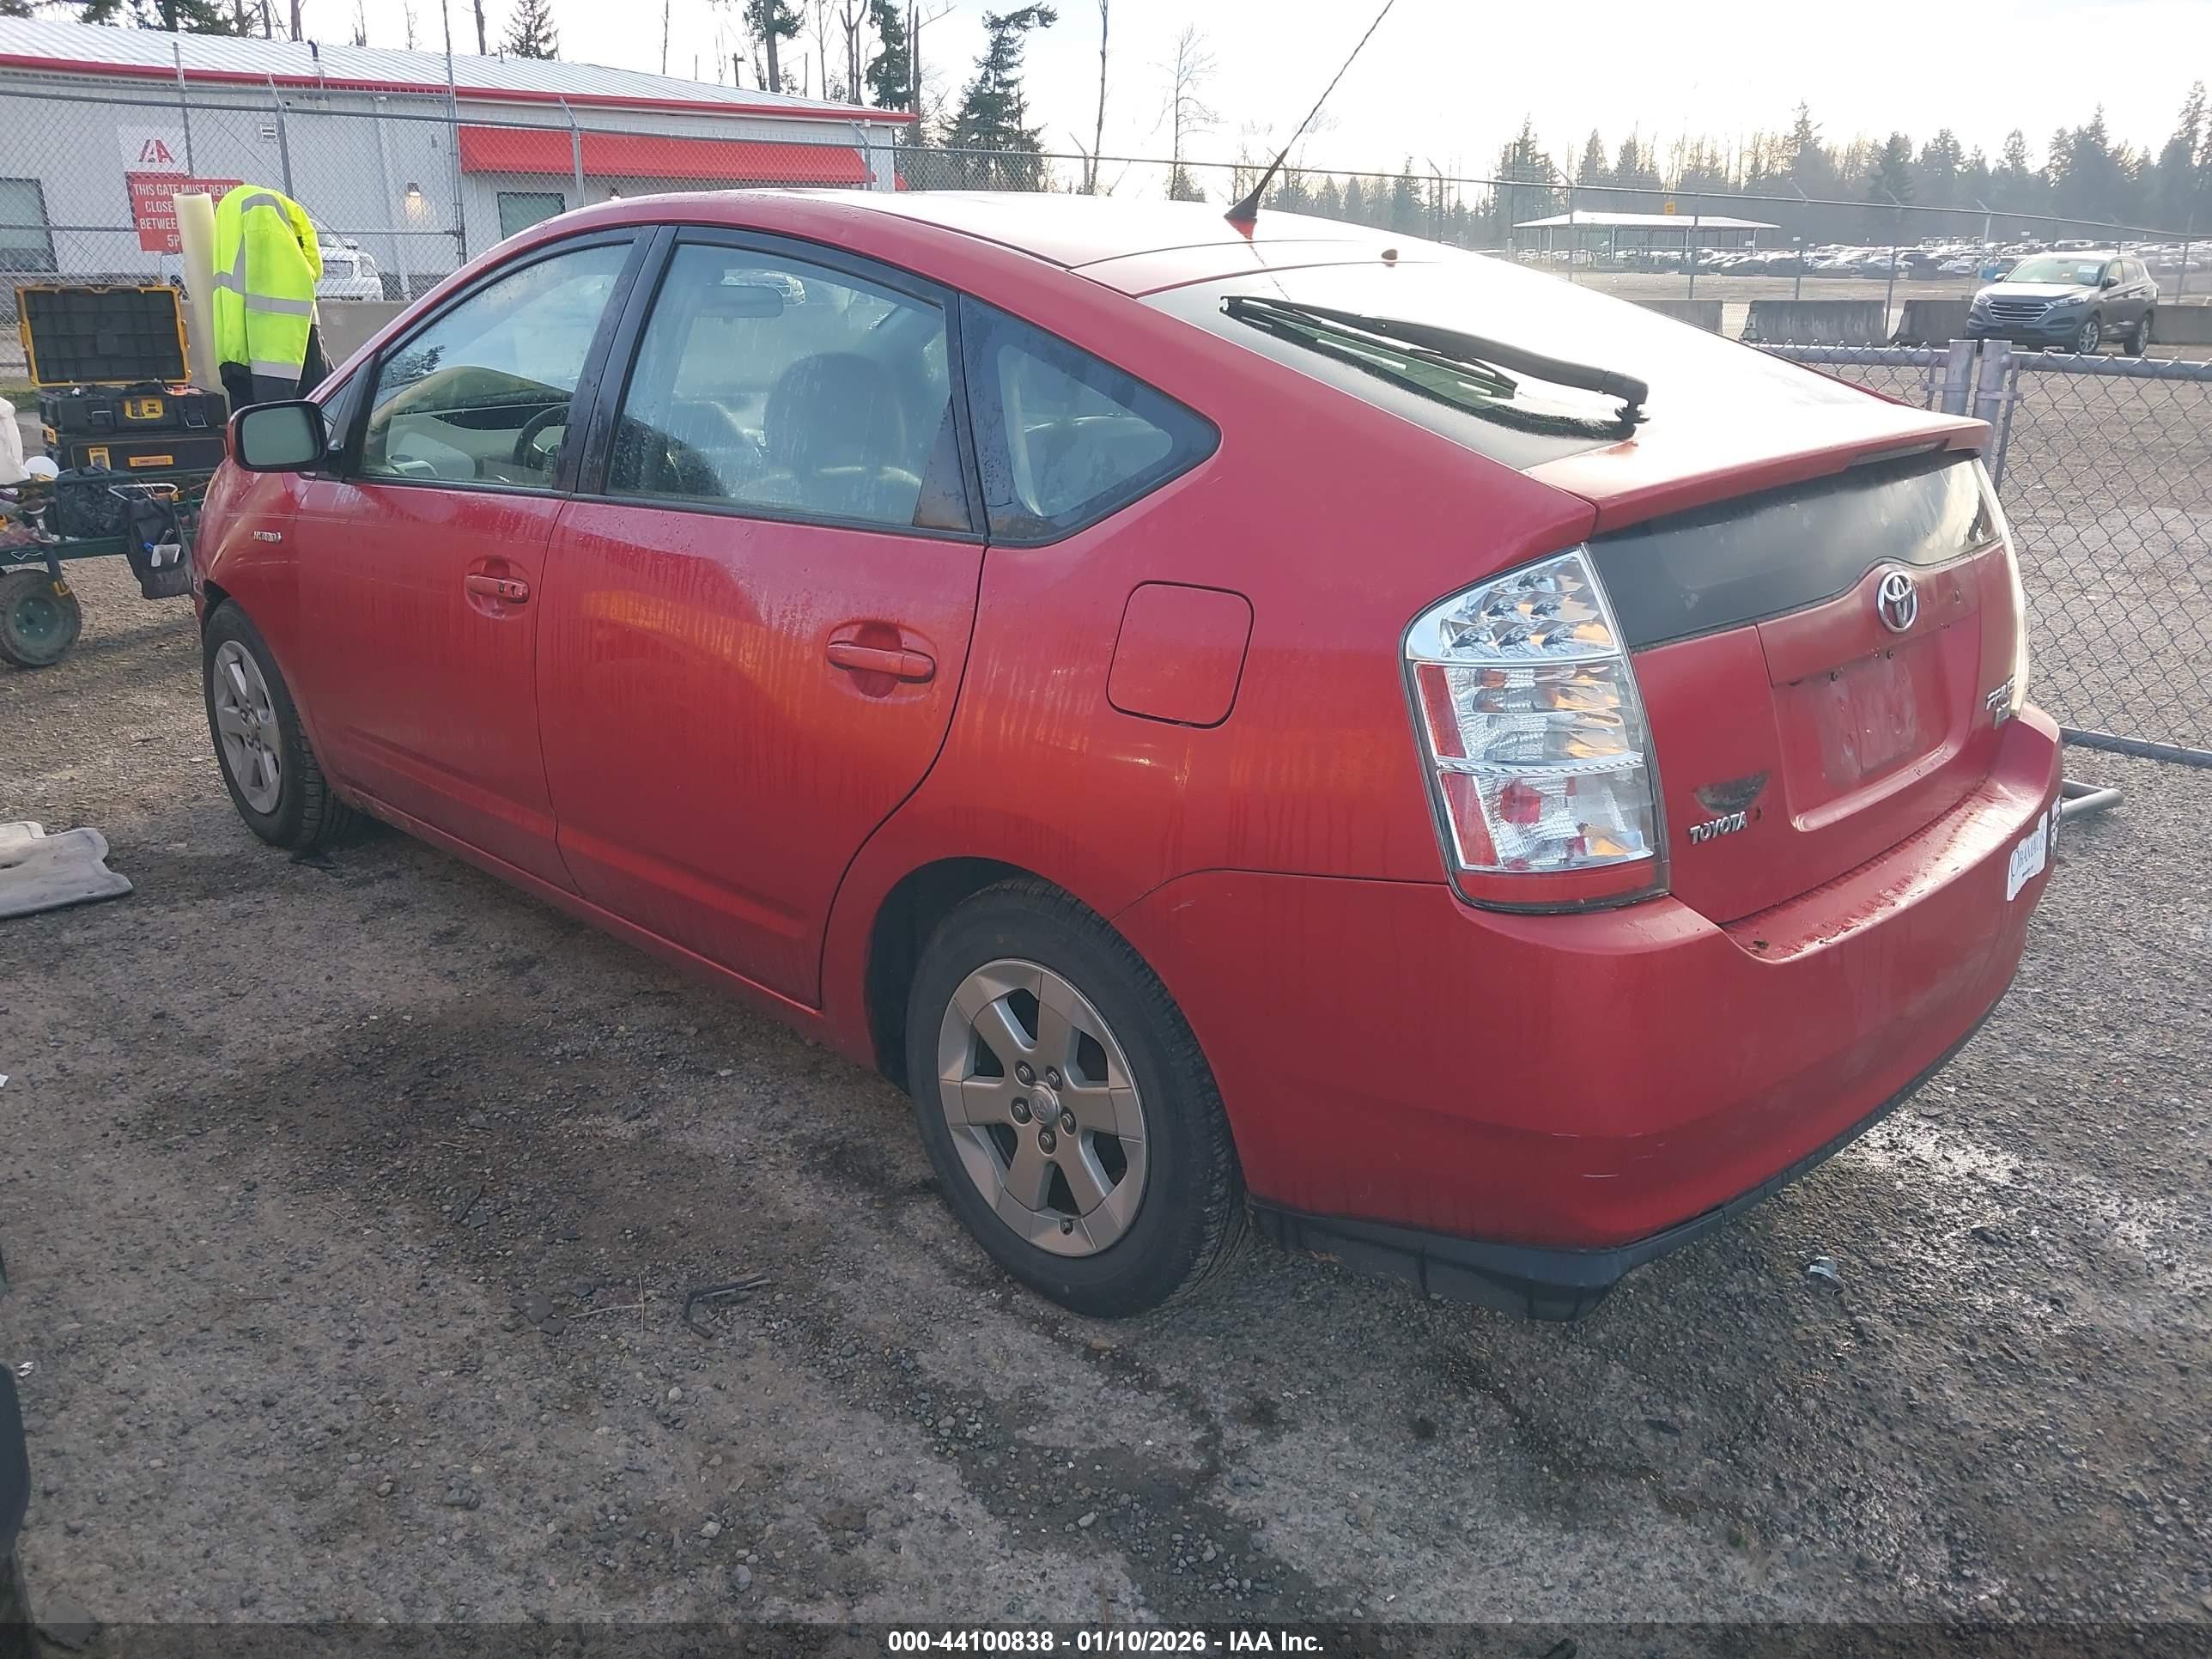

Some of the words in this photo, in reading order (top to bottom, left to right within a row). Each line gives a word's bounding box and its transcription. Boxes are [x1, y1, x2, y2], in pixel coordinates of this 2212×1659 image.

[132, 183, 156, 197] THIS
[156, 183, 179, 197] GATE
[180, 183, 207, 194] MUST
[144, 200, 174, 213] CLOSE
[139, 217, 178, 230] BETWEE
[167, 234, 181, 247] 5P
[1688, 810, 1748, 846] TOYOTA
